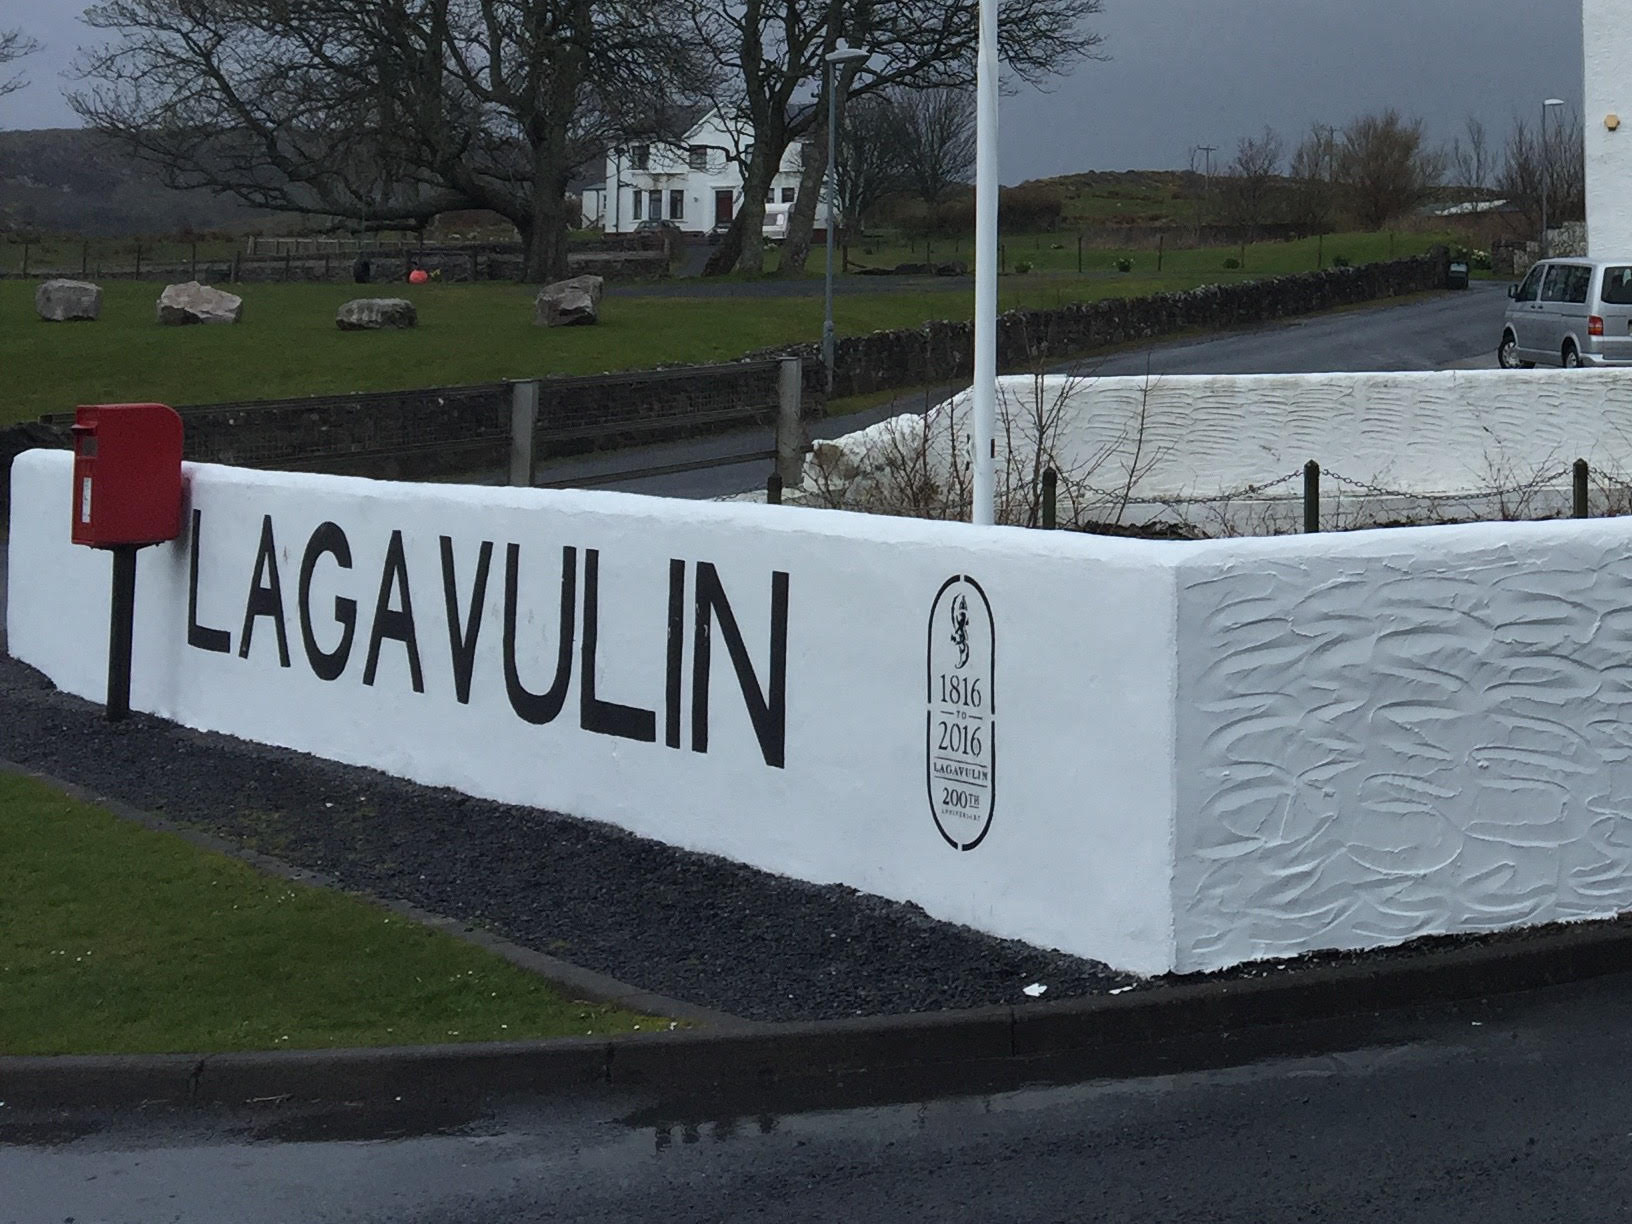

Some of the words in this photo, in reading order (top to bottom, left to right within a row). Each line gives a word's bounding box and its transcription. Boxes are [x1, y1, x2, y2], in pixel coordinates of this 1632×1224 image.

[187, 509, 790, 770] LAGAVULIN
[940, 673, 982, 708] 1816
[956, 710, 967, 720] TO
[938, 721, 982, 757] 2016
[933, 762, 988, 781] LAGAVULIN
